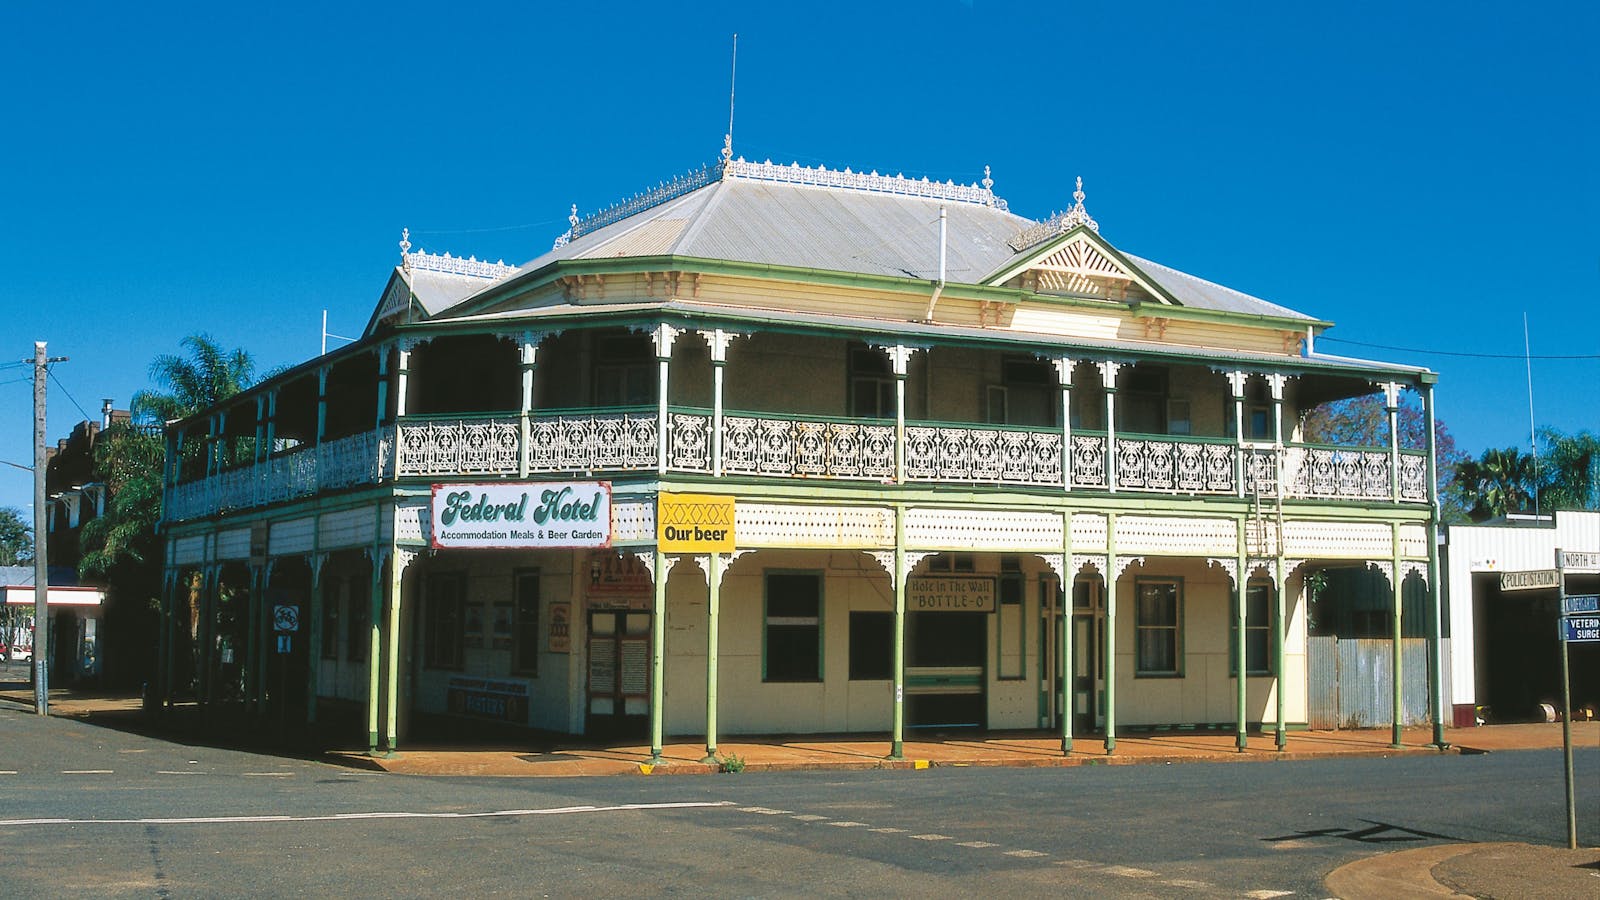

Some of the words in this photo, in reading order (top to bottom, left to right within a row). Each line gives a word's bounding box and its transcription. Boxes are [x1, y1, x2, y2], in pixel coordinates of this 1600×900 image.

[441, 490, 529, 527] Federal
[533, 486, 602, 526] Hotel
[663, 503, 730, 524] XXXX
[440, 530, 507, 540] Accommodation
[510, 530, 535, 539] Meals
[537, 530, 544, 540] &
[548, 530, 568, 539] Beer
[571, 530, 603, 539] Garden
[665, 526, 692, 541] Our
[694, 526, 728, 541] beer
[1565, 553, 1589, 567] NORTH
[912, 580, 934, 592] Hole
[949, 581, 967, 592] The
[968, 581, 990, 592] Wall
[1506, 573, 1528, 588] POLICE
[1529, 570, 1554, 586] STATION
